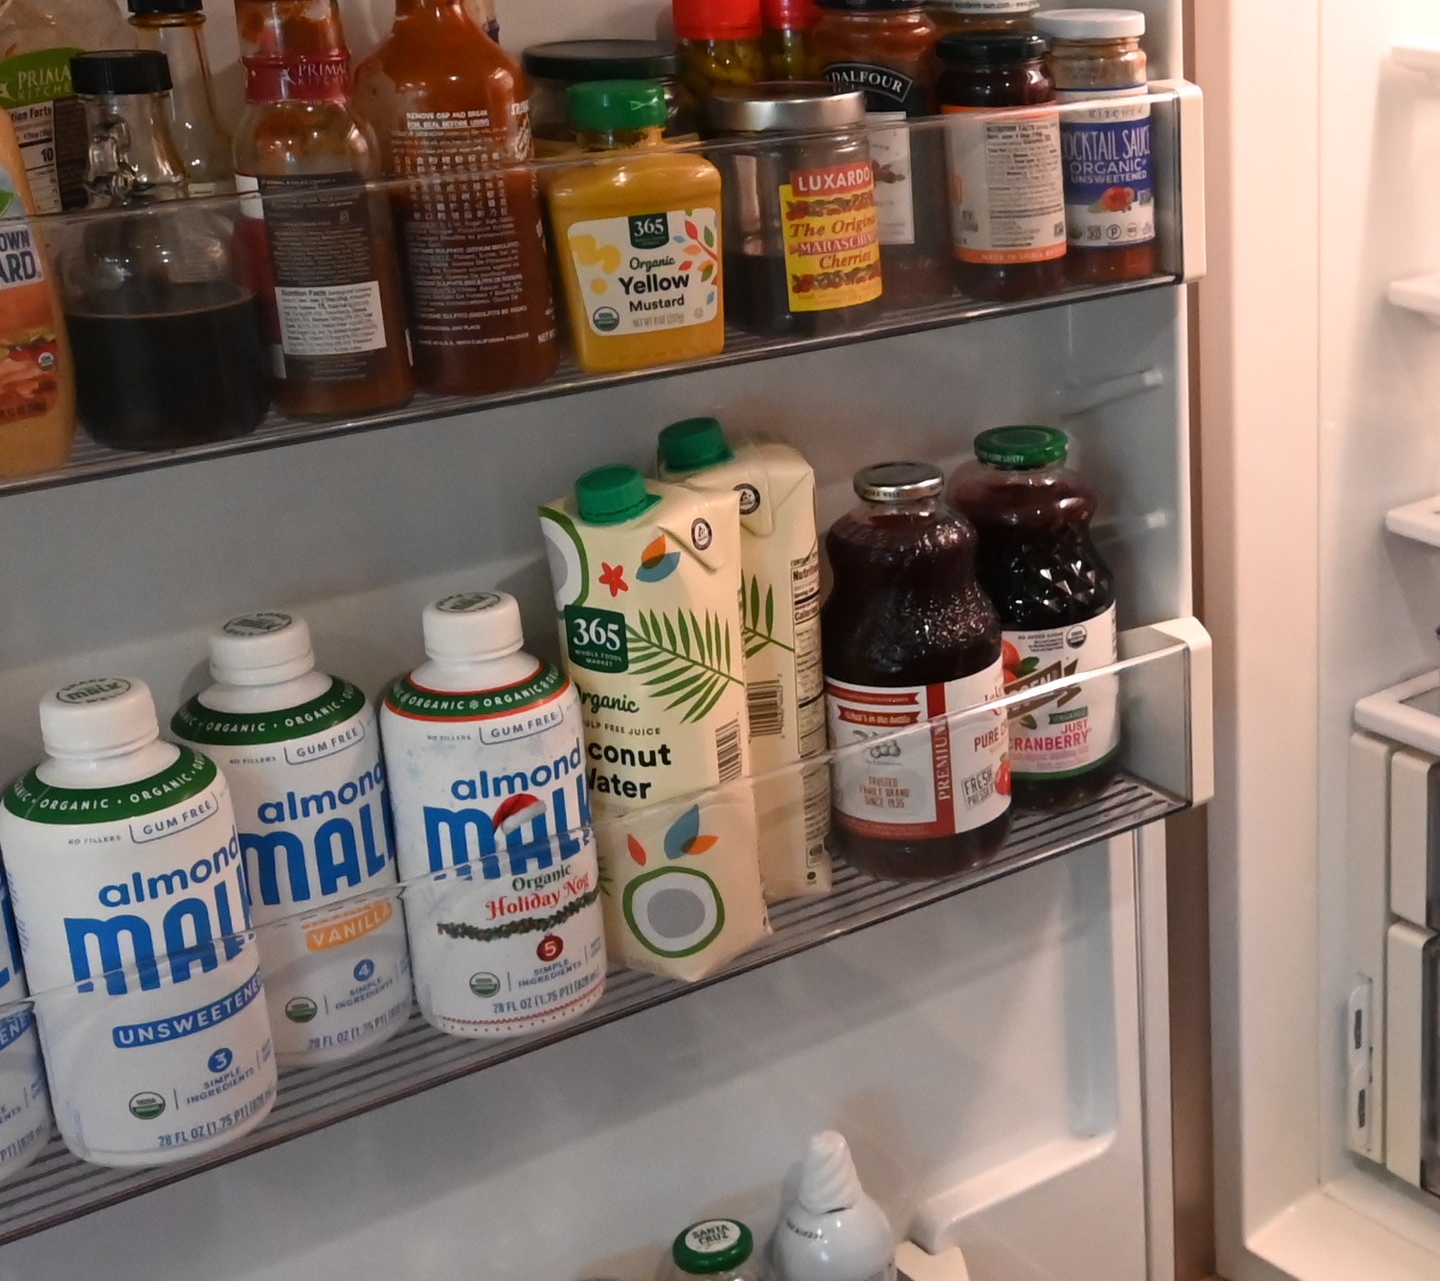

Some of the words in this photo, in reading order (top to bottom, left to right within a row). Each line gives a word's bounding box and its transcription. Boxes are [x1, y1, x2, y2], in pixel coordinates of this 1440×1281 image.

[831, 70, 904, 94] DALFOUR
[41, 148, 54, 162] 10
[1070, 158, 1142, 175] ORGANIC
[798, 166, 870, 191] LUXARDO
[1071, 170, 1147, 185] UNSWEETENED
[633, 219, 664, 237] 365
[790, 223, 825, 238] The
[629, 256, 676, 272] Organic
[618, 274, 690, 295] Yellow
[629, 294, 685, 313] Mustard
[573, 618, 620, 650] 365
[408, 696, 464, 710] ORGANIC
[483, 684, 542, 707] ORGANIC
[285, 701, 341, 727] ORGANIC
[491, 724, 524, 738] GUM
[528, 711, 557, 730] FREE
[206, 721, 266, 733] ORGANIC
[605, 723, 625, 733] FREE
[628, 726, 661, 736] JUICE
[1061, 719, 1089, 735] JUST
[297, 742, 328, 757] GUM
[332, 729, 359, 747] FREE
[974, 731, 999, 752] PURE
[587, 742, 671, 767] conut
[933, 720, 952, 800] PREMIUM
[451, 737, 582, 800] almond
[129, 773, 191, 804] ORGANIC
[964, 766, 993, 795] FRESH
[40, 798, 109, 810] ORGANIC
[142, 817, 178, 835] GUM
[182, 800, 212, 822] FREE
[98, 823, 239, 908] almond
[512, 864, 571, 892] Organic
[486, 890, 561, 920] Holiday
[563, 872, 590, 896] Nog
[312, 904, 391, 946] VANILLA
[544, 942, 556, 956] 5
[359, 964, 369, 975] 4
[518, 961, 582, 987] INGREDIENTS
[533, 959, 568, 976] SIMPLE
[335, 979, 393, 1010] INGREDIENTS
[349, 977, 382, 996] SIMPLE
[119, 973, 263, 1045] UNSWEETENE
[215, 1053, 227, 1069] 3
[186, 1067, 255, 1104] INGREDIENTS
[203, 1066, 241, 1090] SIMPLE
[691, 1225, 730, 1239] SANTA
[698, 1232, 730, 1244] CRUZ
